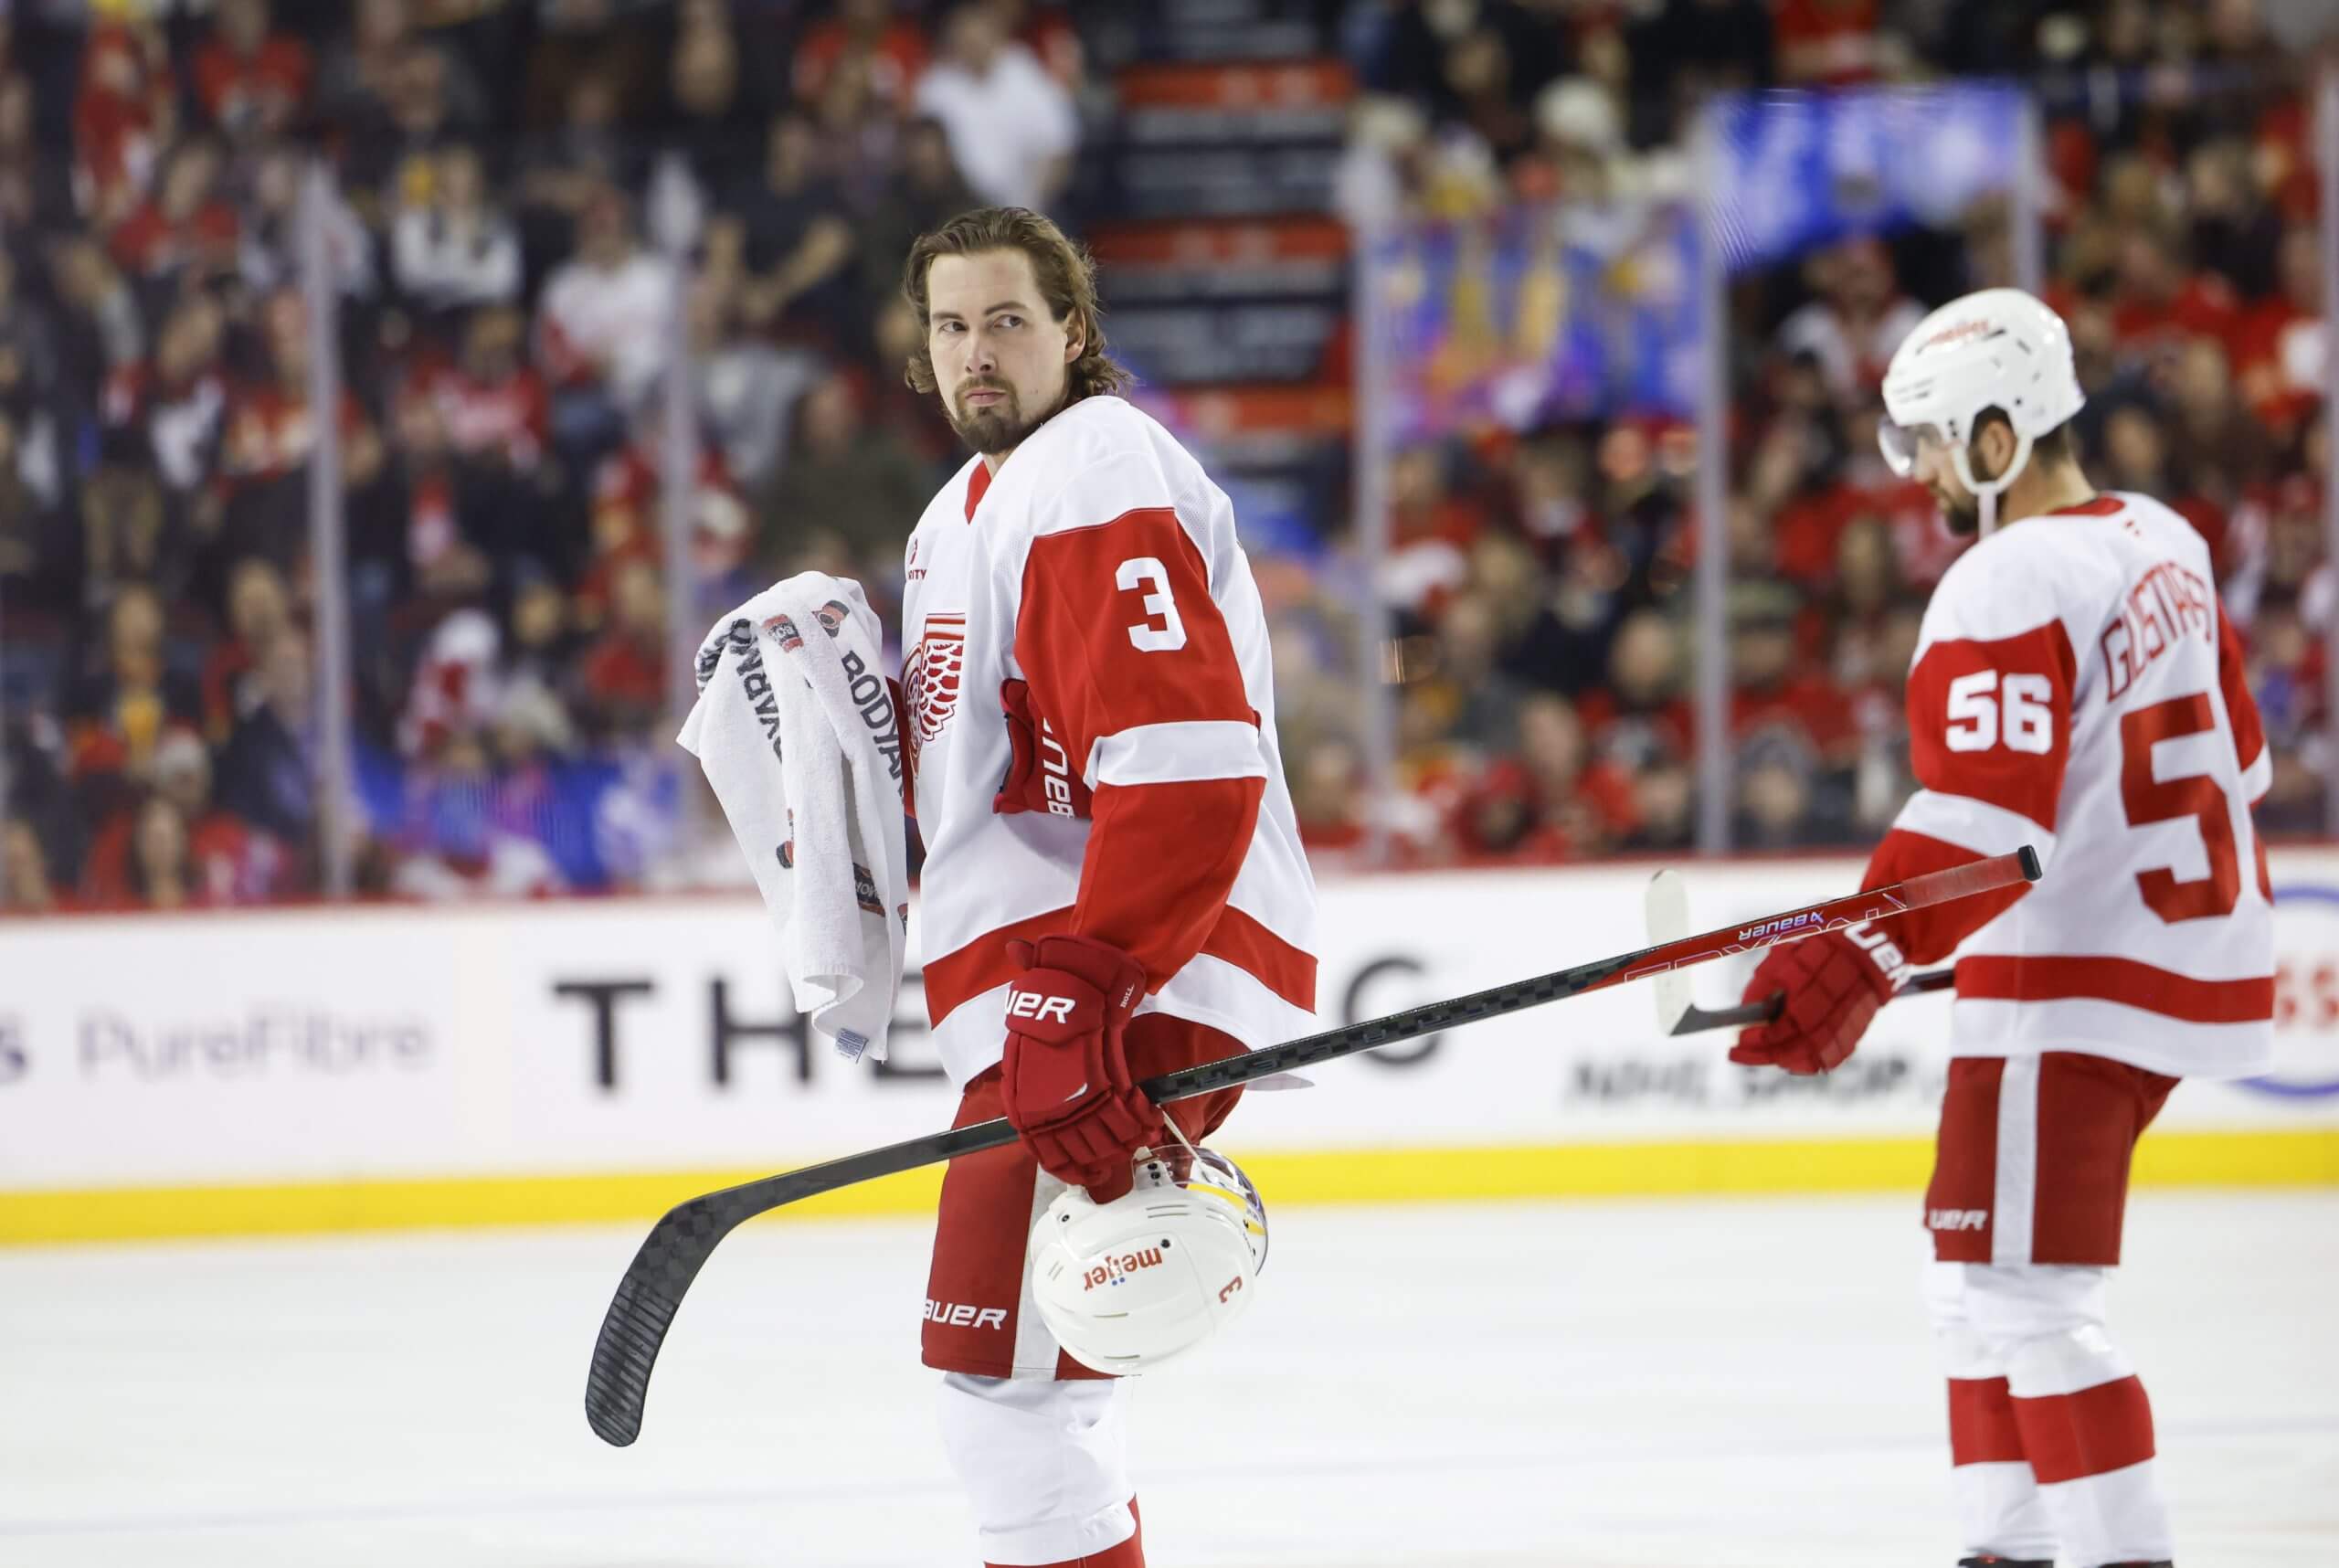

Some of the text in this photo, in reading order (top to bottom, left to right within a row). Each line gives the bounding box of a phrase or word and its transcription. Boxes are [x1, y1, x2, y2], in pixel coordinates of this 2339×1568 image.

[1116, 556, 1188, 652] 3
[841, 650, 904, 798] BODYA
[1946, 669, 2053, 755] 56
[1042, 716, 1075, 820] BAU
[1083, 1246, 1163, 1292] meijer
